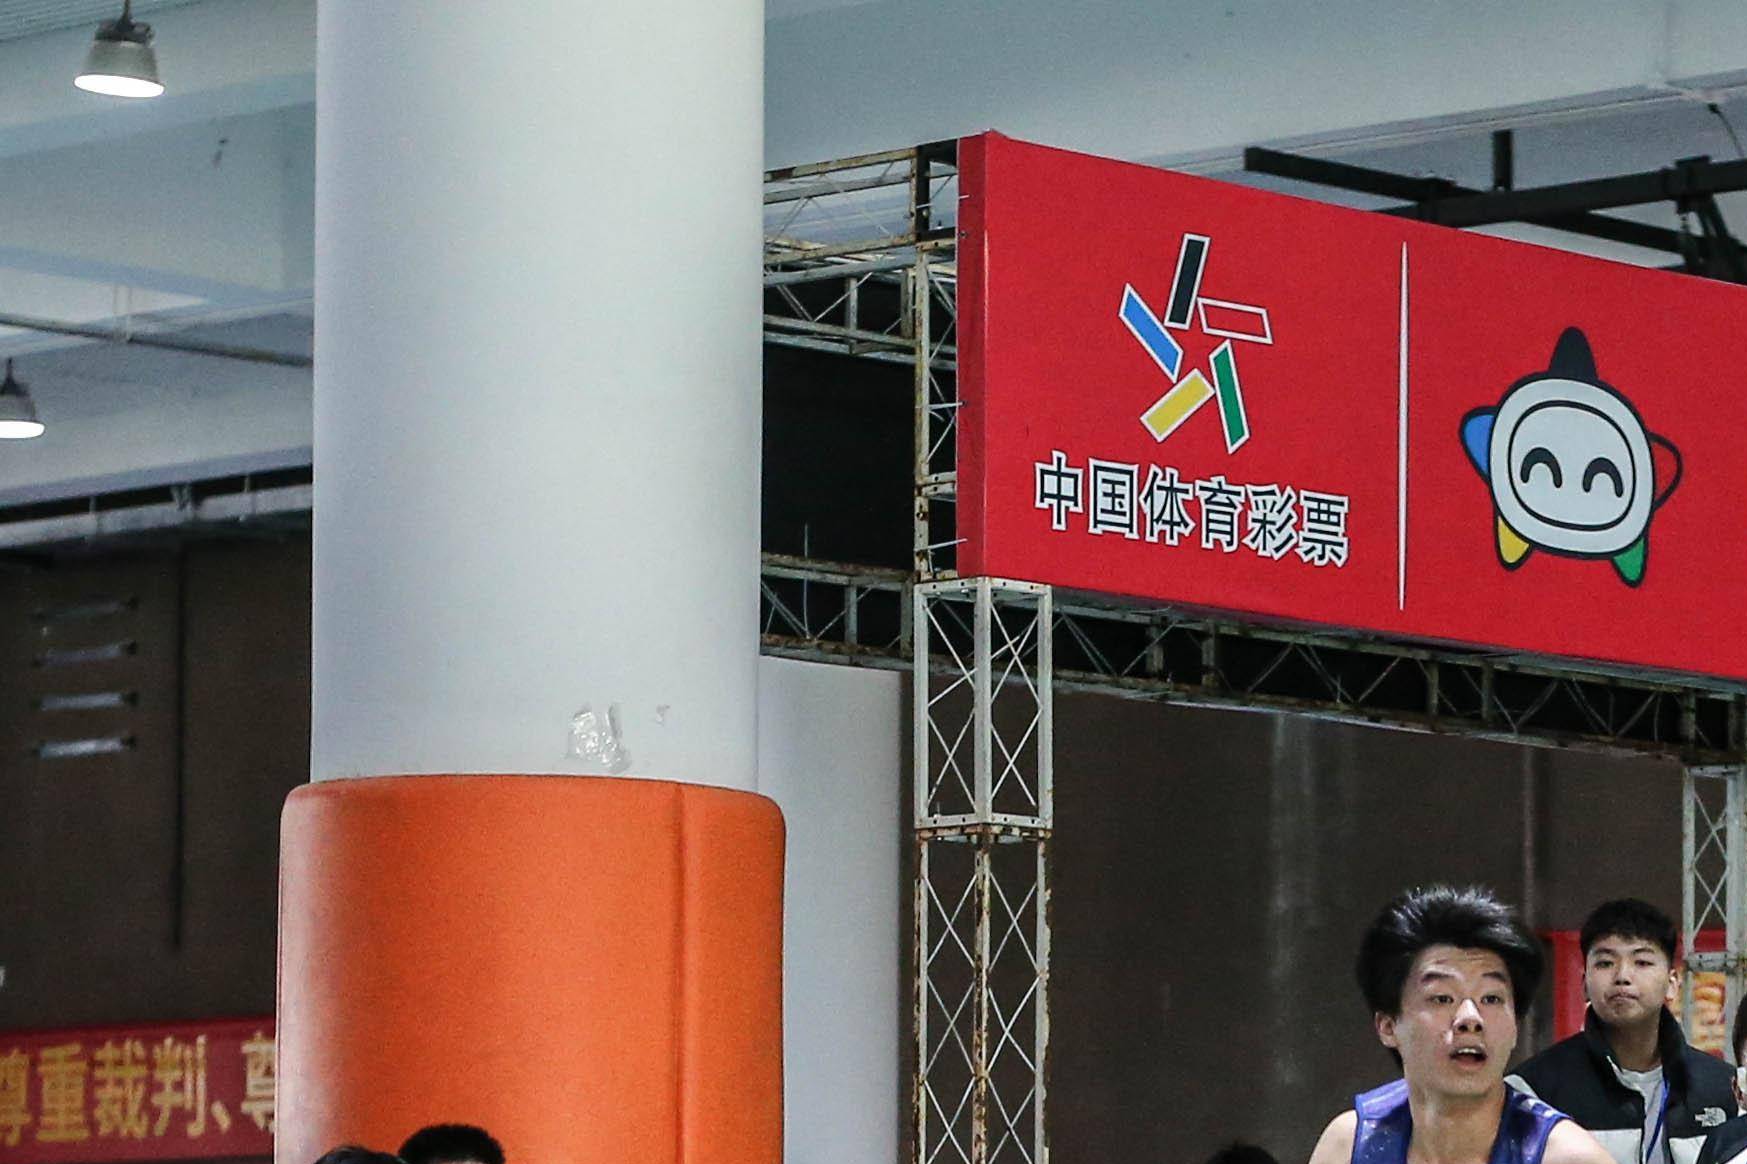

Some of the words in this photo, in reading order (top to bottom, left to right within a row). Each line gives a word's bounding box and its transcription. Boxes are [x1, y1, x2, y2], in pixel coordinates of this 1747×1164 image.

[1036, 452, 1348, 566] 中国体育彩票
